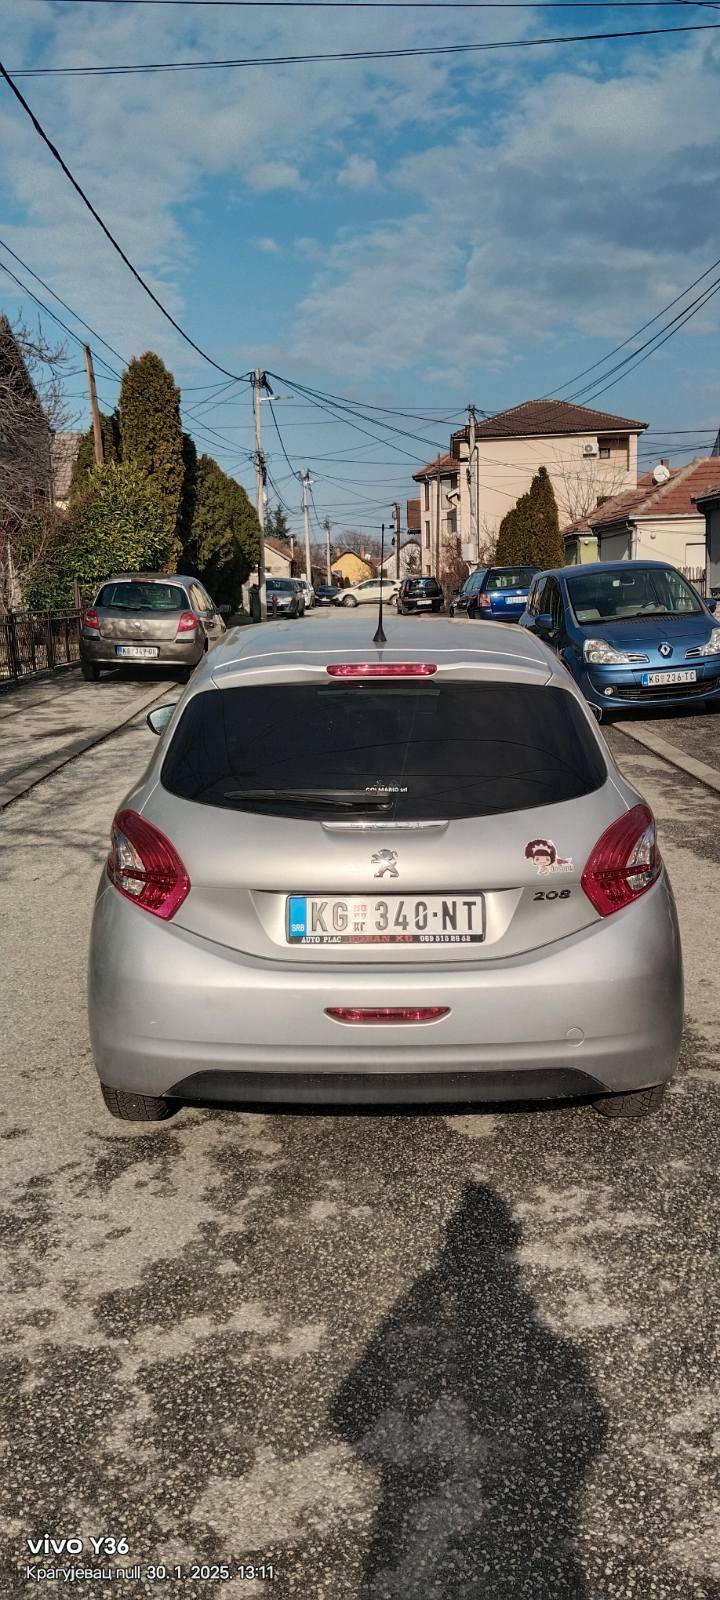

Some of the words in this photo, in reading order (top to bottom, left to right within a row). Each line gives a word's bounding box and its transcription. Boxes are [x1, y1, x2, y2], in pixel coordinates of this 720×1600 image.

[649, 674, 660, 684] KG
[533, 889, 571, 901] 208
[311, 901, 348, 932] KG
[291, 923, 304, 932] SRB
